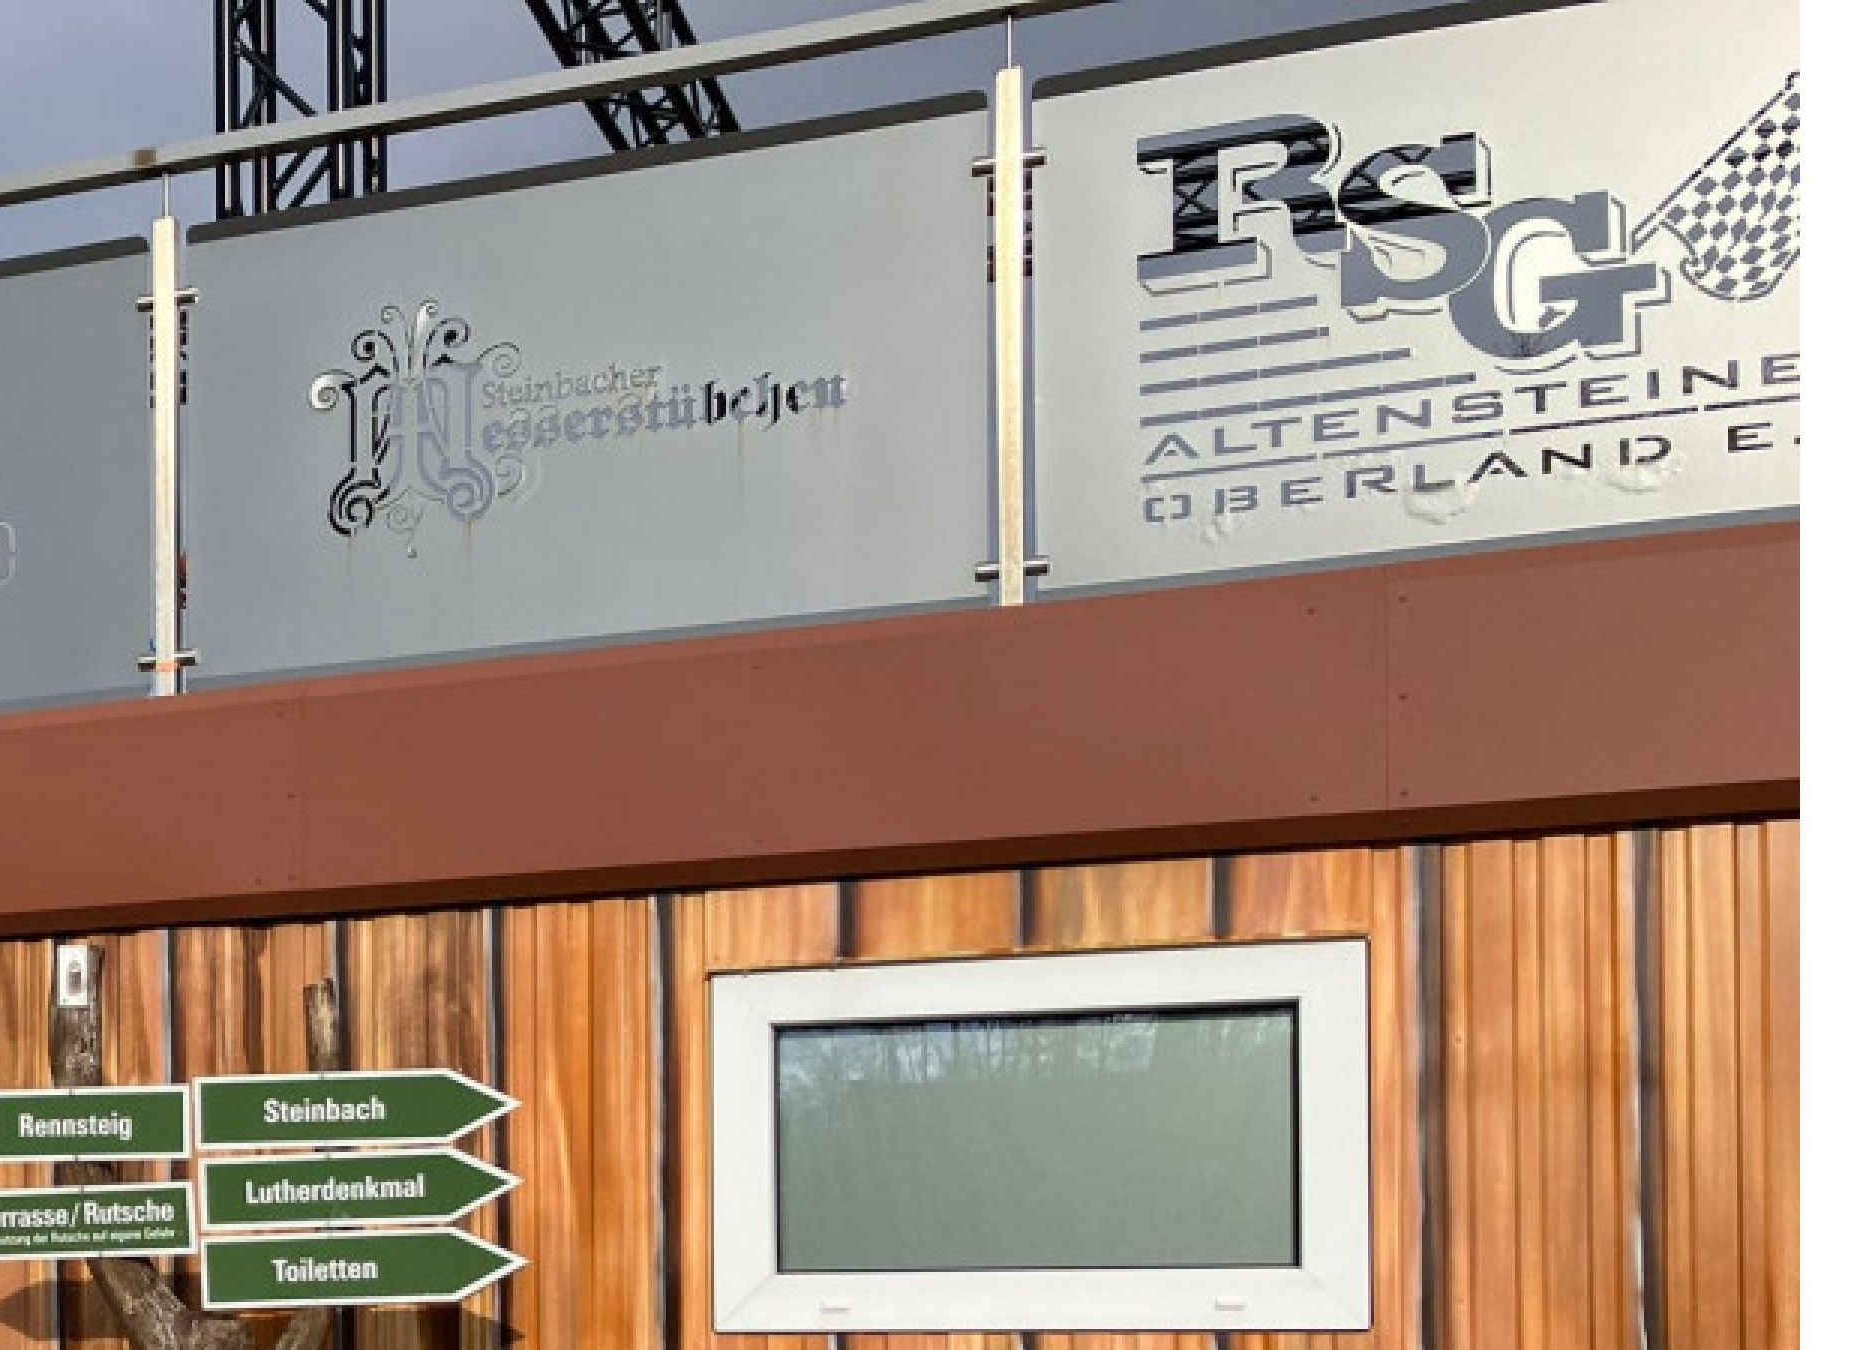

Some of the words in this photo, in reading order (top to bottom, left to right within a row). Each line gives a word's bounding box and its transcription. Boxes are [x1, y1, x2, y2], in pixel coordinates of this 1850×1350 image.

[1137, 112, 1664, 366] RSG
[482, 363, 662, 408] Steinbacher
[1144, 435, 1672, 522] OBERLAND
[263, 1095, 387, 1123] Steinbach
[17, 1111, 133, 1141] Rennsteig
[245, 1172, 427, 1204] Lutherdenkmal
[270, 1256, 379, 1282] Toiletten
